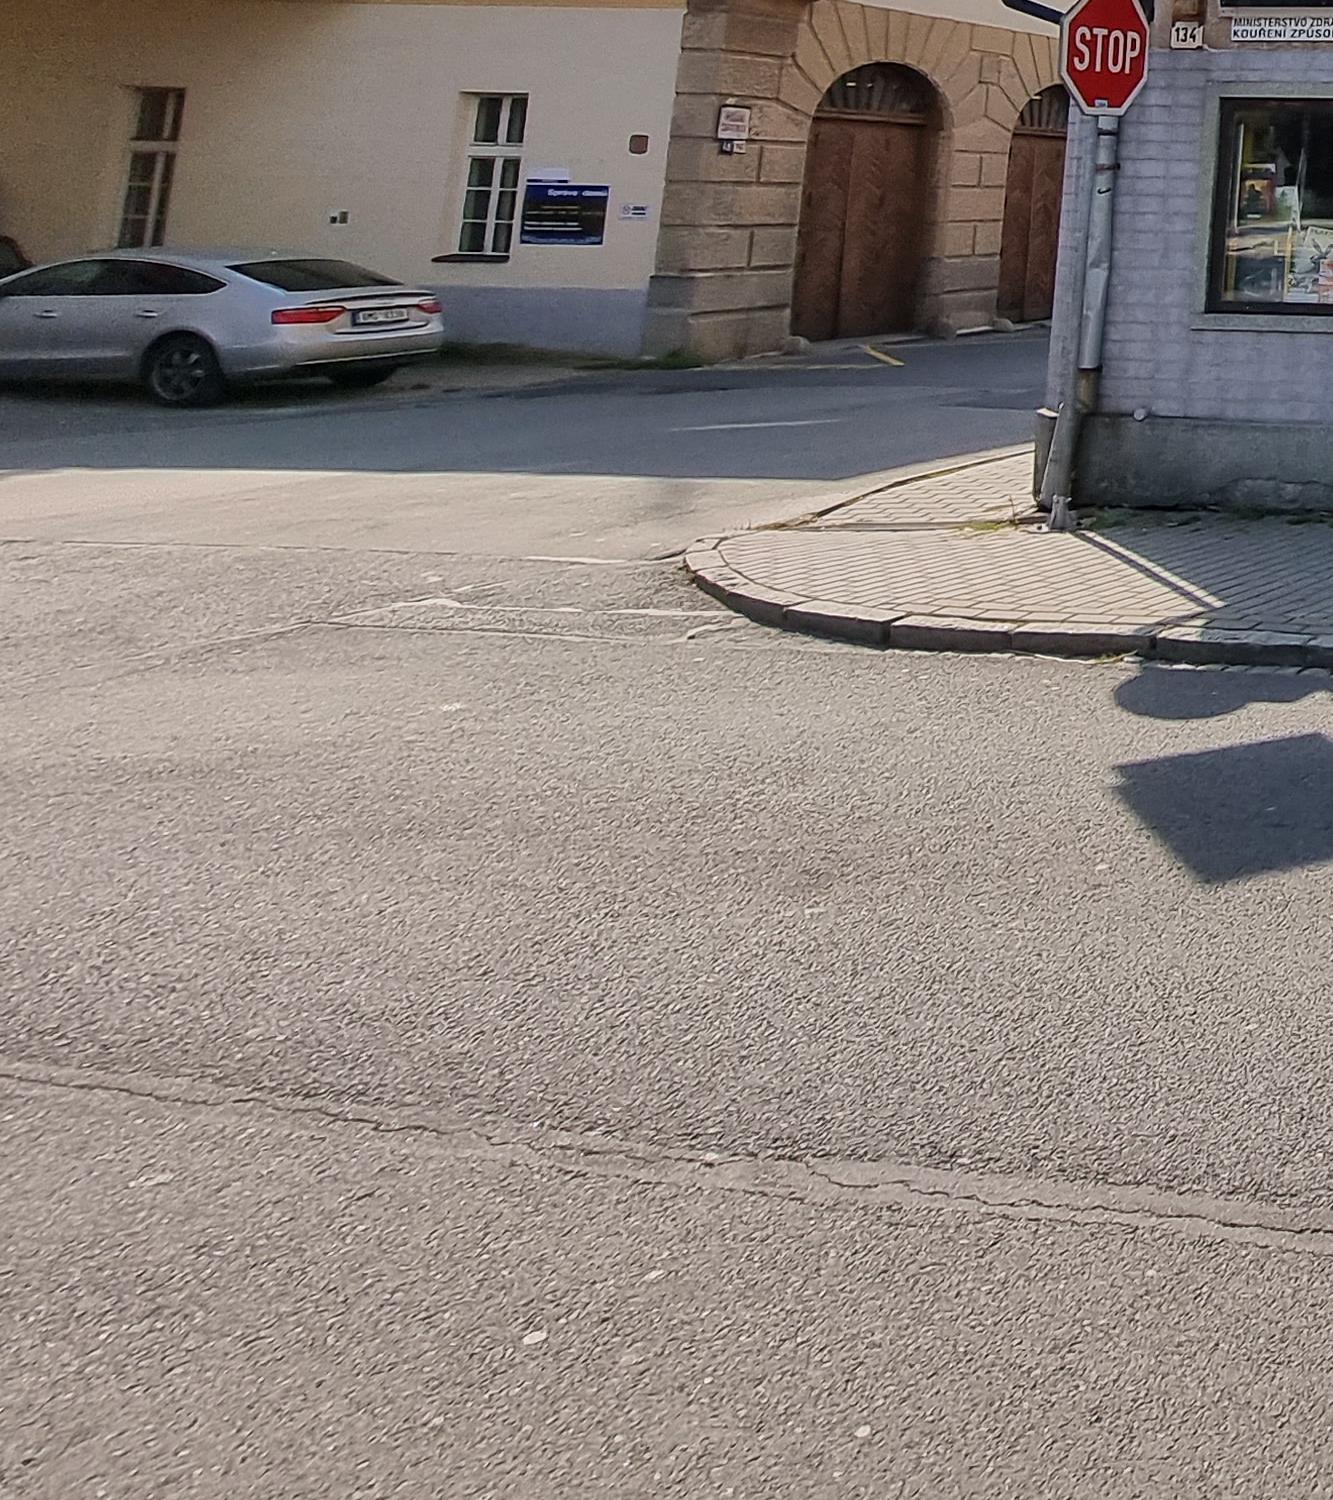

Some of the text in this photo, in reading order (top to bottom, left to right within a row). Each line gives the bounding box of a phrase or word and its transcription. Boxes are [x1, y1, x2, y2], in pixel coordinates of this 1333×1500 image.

[1234, 17, 1307, 28] MINISTERSTVO
[1174, 26, 1197, 43] 134
[1073, 26, 1141, 74] STOP
